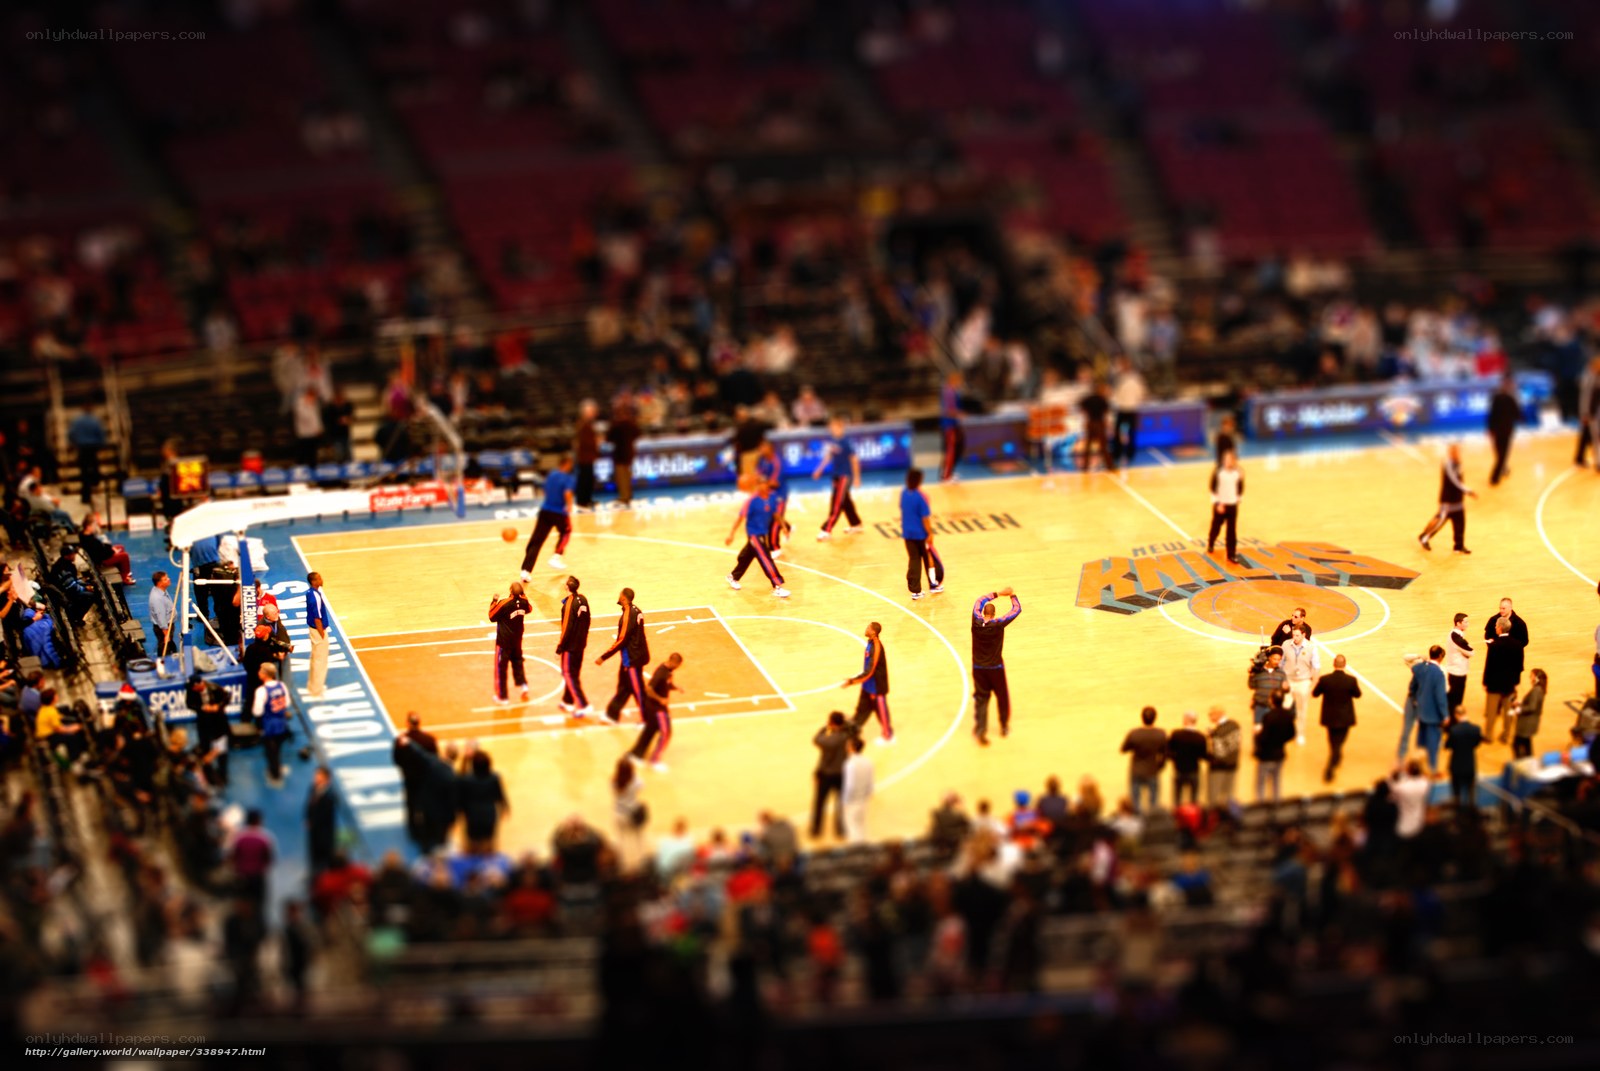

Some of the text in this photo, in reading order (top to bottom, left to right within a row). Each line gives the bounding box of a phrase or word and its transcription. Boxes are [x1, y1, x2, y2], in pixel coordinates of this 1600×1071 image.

[873, 512, 1022, 539] GRDEN
[1132, 541, 1187, 557] NEW
[1075, 541, 1421, 615] KNICKS
[242, 585, 257, 640] SPONGETECH
[297, 681, 392, 761] YORK
